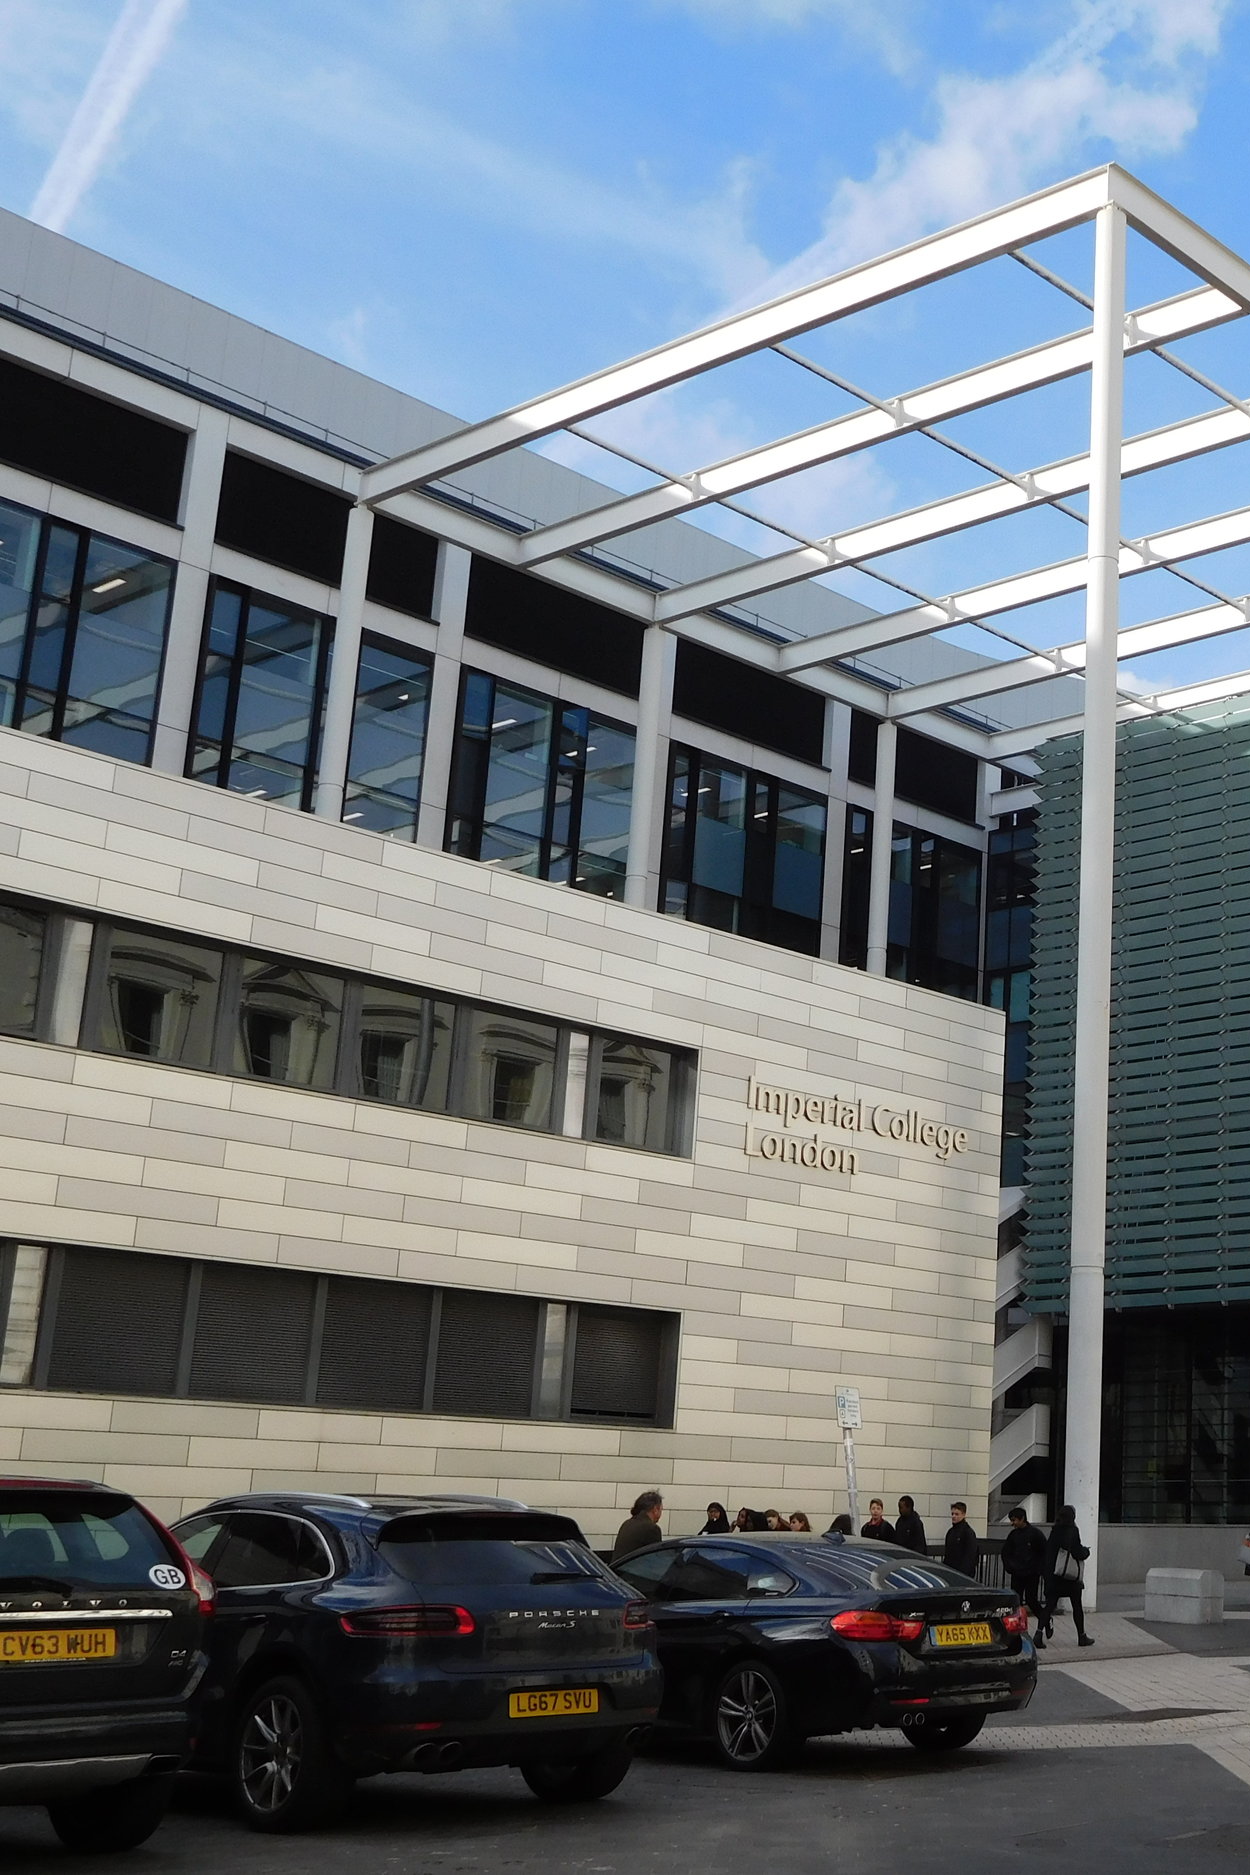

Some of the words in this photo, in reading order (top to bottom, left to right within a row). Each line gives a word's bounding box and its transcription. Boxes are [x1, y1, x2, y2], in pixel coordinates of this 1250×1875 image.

[747, 1075, 865, 1132] Imperial
[872, 1104, 968, 1160] College
[744, 1121, 859, 1174] London
[153, 1568, 182, 1585] GB
[0, 1599, 128, 1610] VOLVO
[509, 1610, 600, 1618] PORSCHE
[566, 1620, 577, 1628] S
[936, 1627, 966, 1643] YA65
[968, 1626, 988, 1642] KXX
[2, 1635, 60, 1656] CV63
[66, 1633, 107, 1655] WUH
[516, 1693, 560, 1713] LG67
[563, 1691, 592, 1710] SVU
